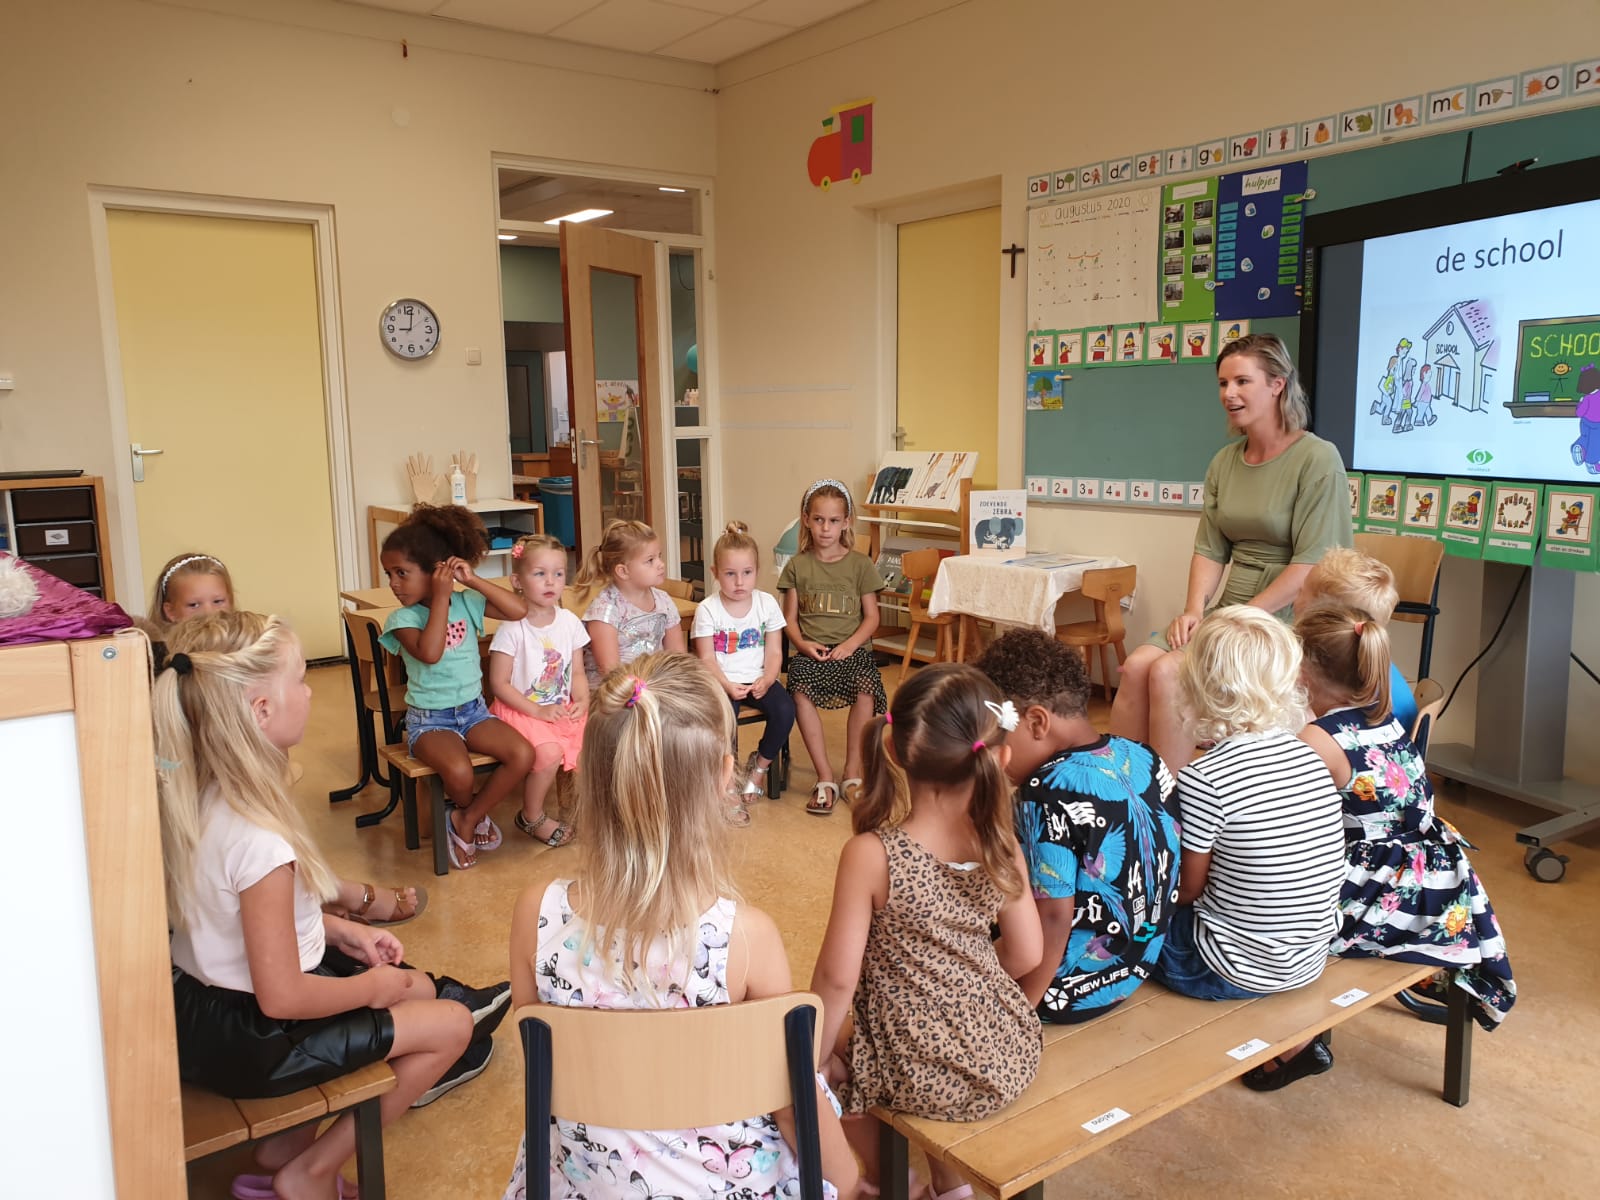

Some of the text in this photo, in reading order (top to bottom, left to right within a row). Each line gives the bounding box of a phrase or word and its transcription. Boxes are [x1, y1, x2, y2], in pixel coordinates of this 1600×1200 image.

[1030, 182, 1038, 193] a
[1056, 177, 1065, 190] b
[1082, 172, 1090, 183] c
[1110, 164, 1119, 179] d
[1138, 160, 1147, 172] e
[1199, 149, 1209, 165] g
[1233, 142, 1242, 157] h
[1344, 116, 1353, 132] k
[1432, 97, 1451, 114] m
[1478, 91, 1491, 107] n
[1544, 75, 1560, 90] o
[1575, 69, 1591, 90] p
[1244, 175, 1278, 190] hulpjes
[1107, 197, 1131, 211] 2020
[1435, 228, 1564, 274] de school
[403, 305, 414, 316] 12
[387, 324, 395, 333] 9
[425, 325, 433, 334] 3
[407, 344, 415, 353] 6
[1435, 343, 1461, 356] SCHOOL
[1030, 482, 1199, 500] 1 2 3 4 5 6 7
[1073, 966, 1130, 997] NEW LIFE
